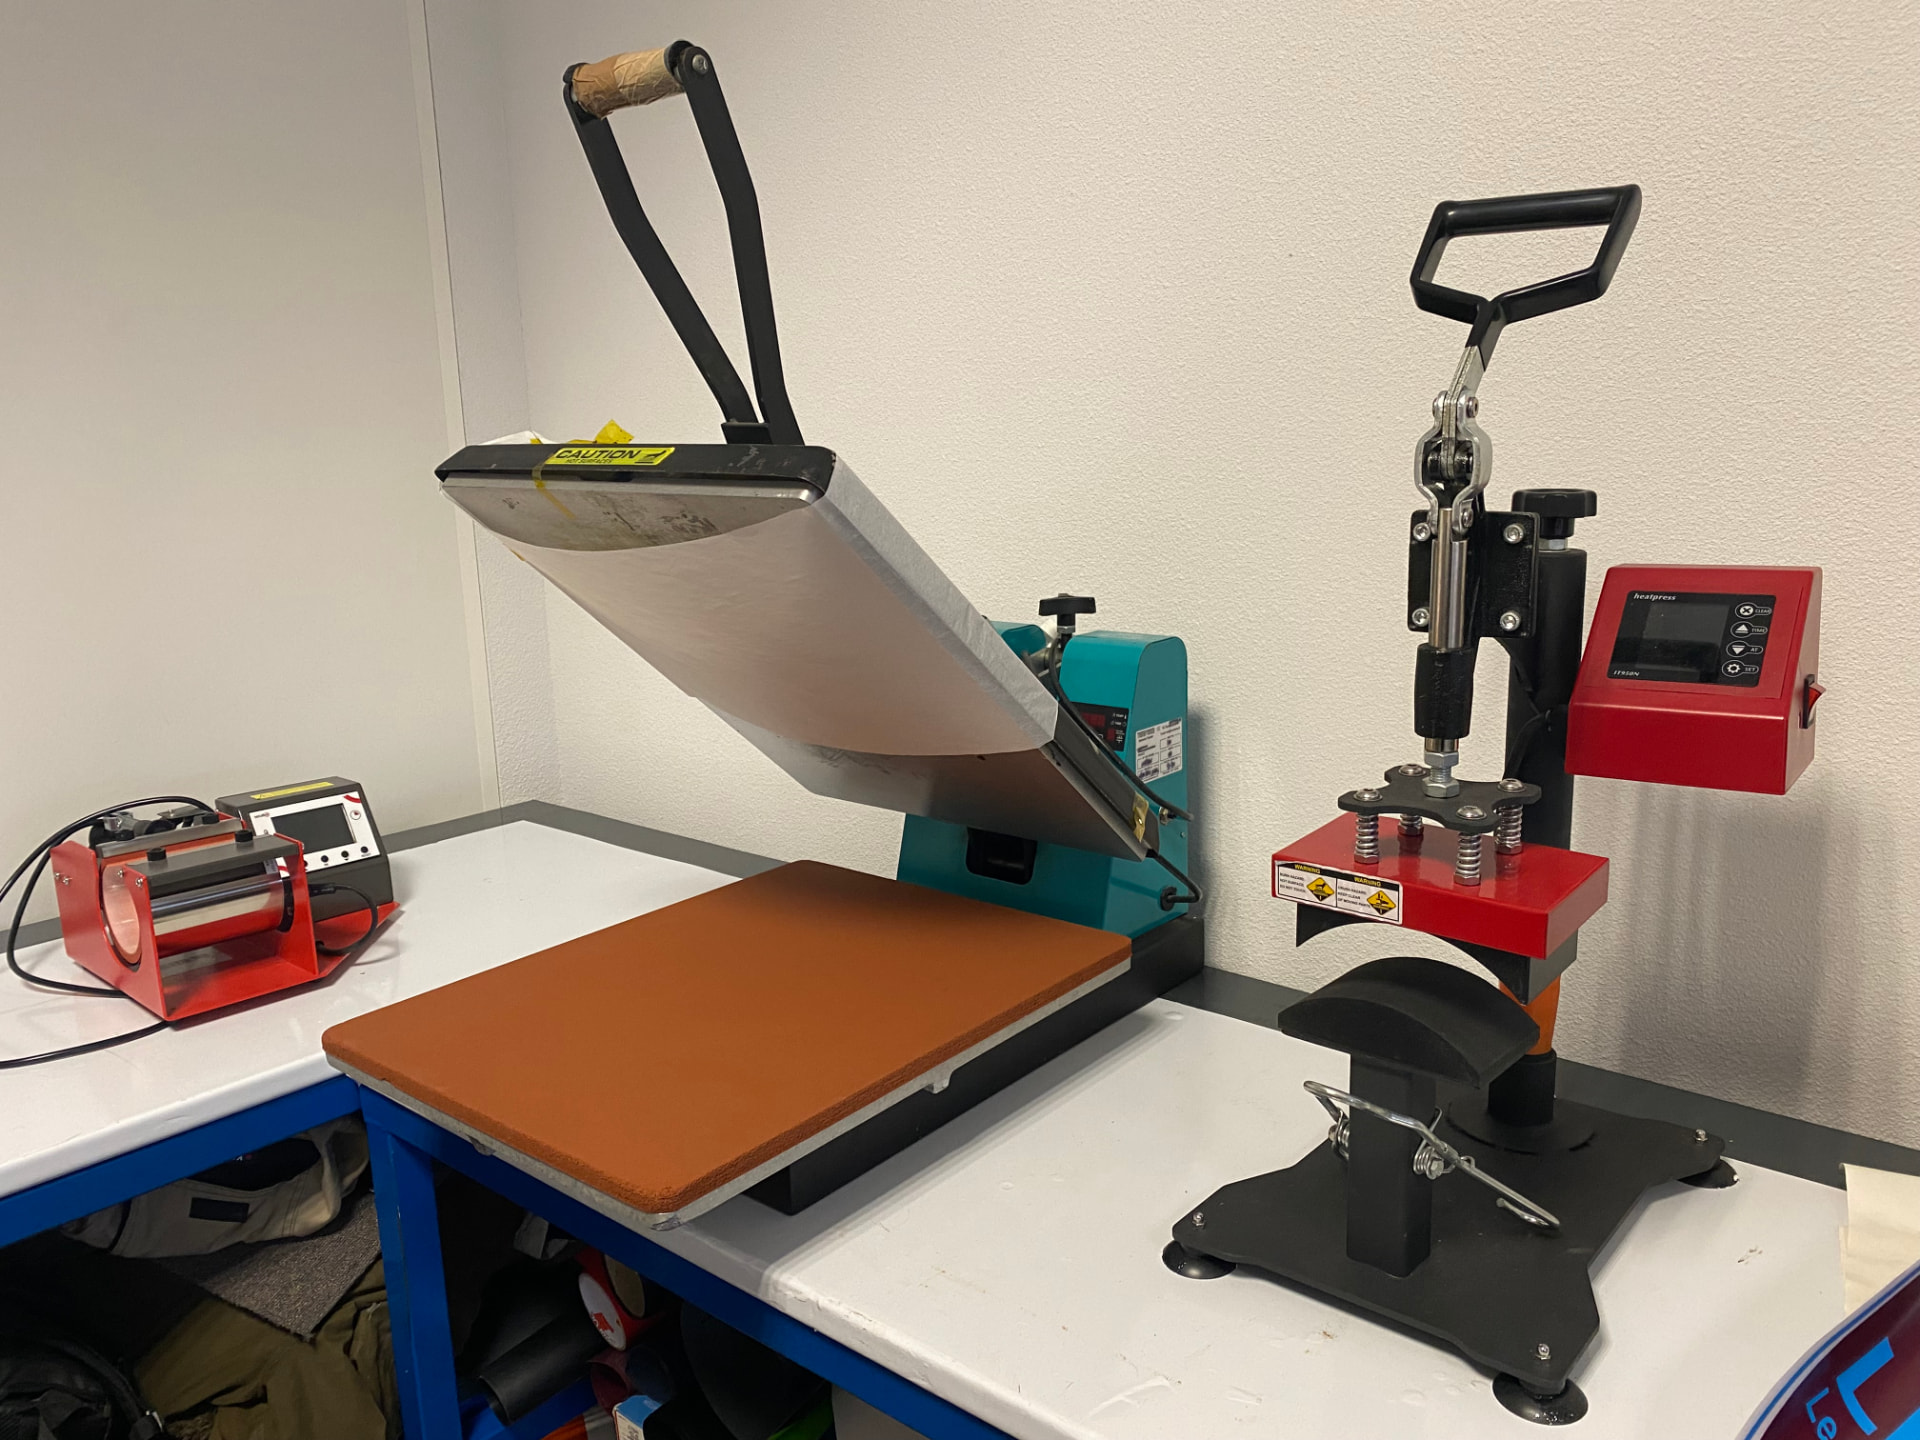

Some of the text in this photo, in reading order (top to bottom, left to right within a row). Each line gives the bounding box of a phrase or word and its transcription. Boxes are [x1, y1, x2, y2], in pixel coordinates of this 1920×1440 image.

[556, 450, 642, 459] CAUTION
[1633, 592, 1677, 602] heatpress
[1294, 864, 1320, 874] WARNING
[1354, 877, 1381, 887] WARNING
